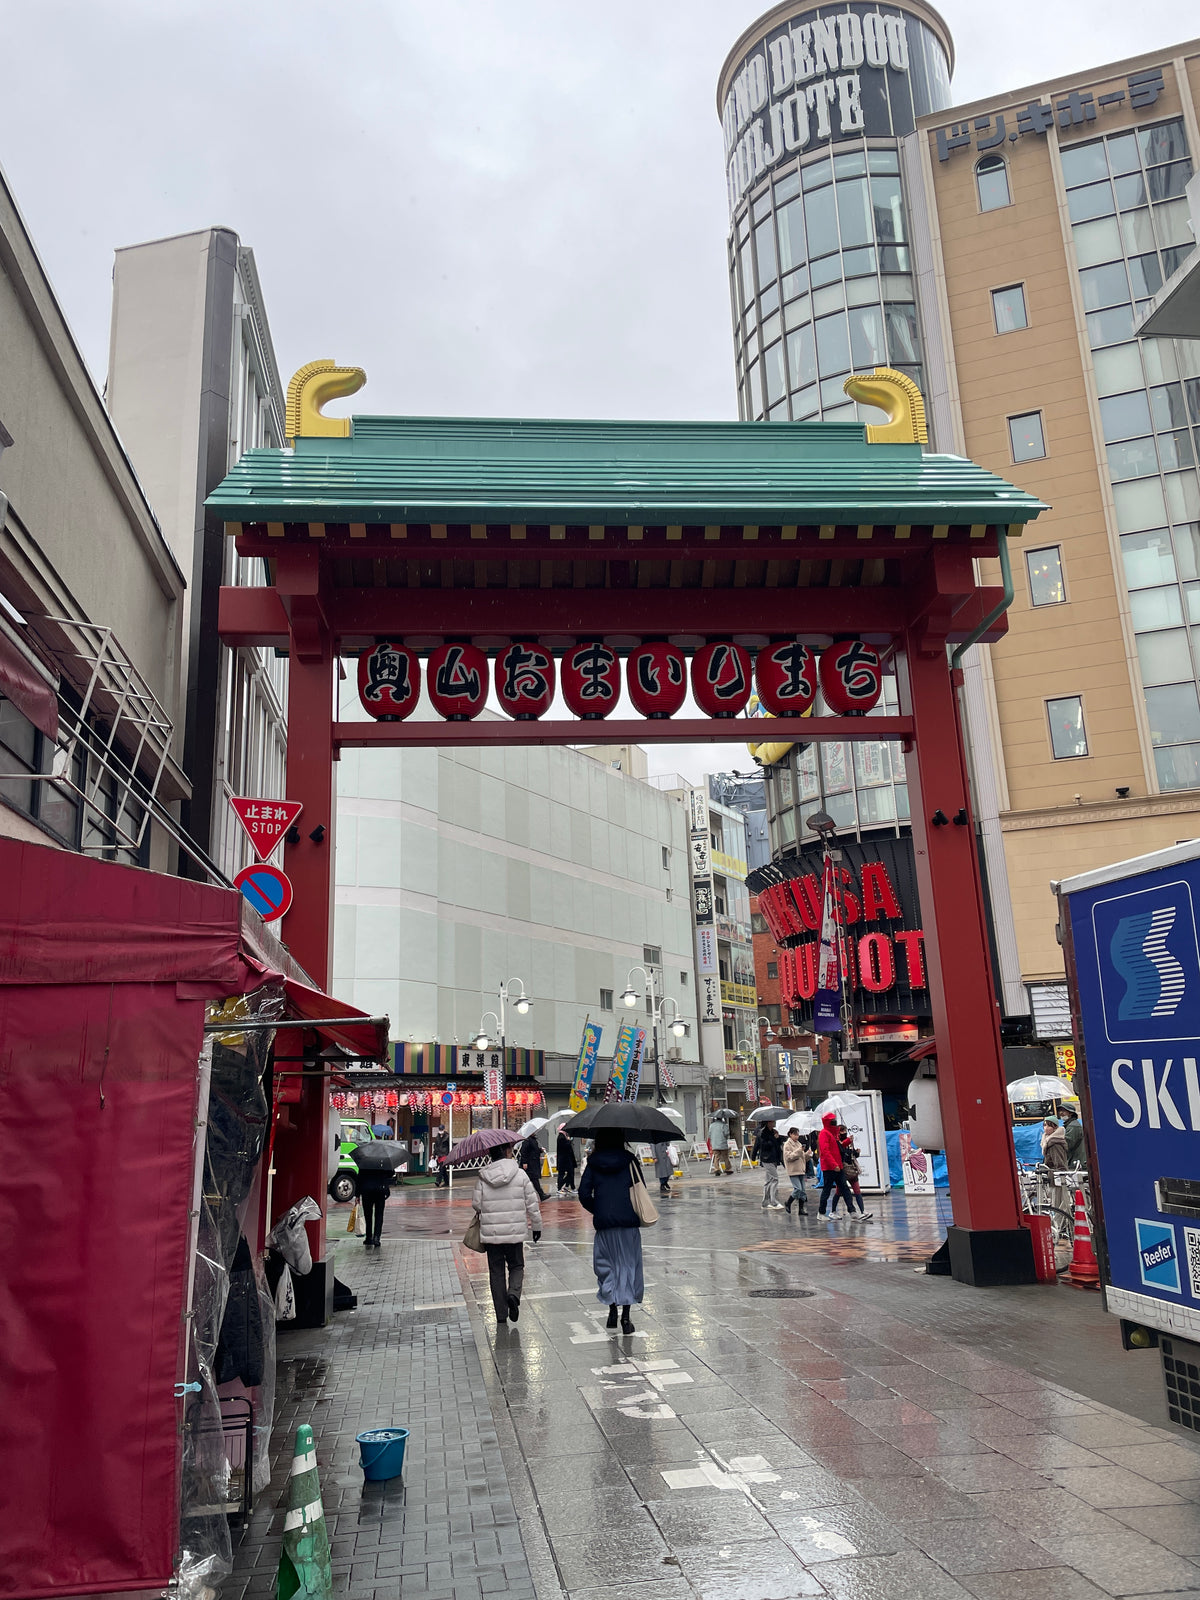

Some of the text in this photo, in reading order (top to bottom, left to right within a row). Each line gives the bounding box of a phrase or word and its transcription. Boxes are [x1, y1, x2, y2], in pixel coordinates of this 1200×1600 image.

[769, 13, 910, 97] DENDOU
[244, 804, 288, 820] 止まれ
[251, 822, 281, 835] STOP
[462, 1053, 499, 1068] 東洋館
[1143, 1244, 1172, 1267] Reefer
